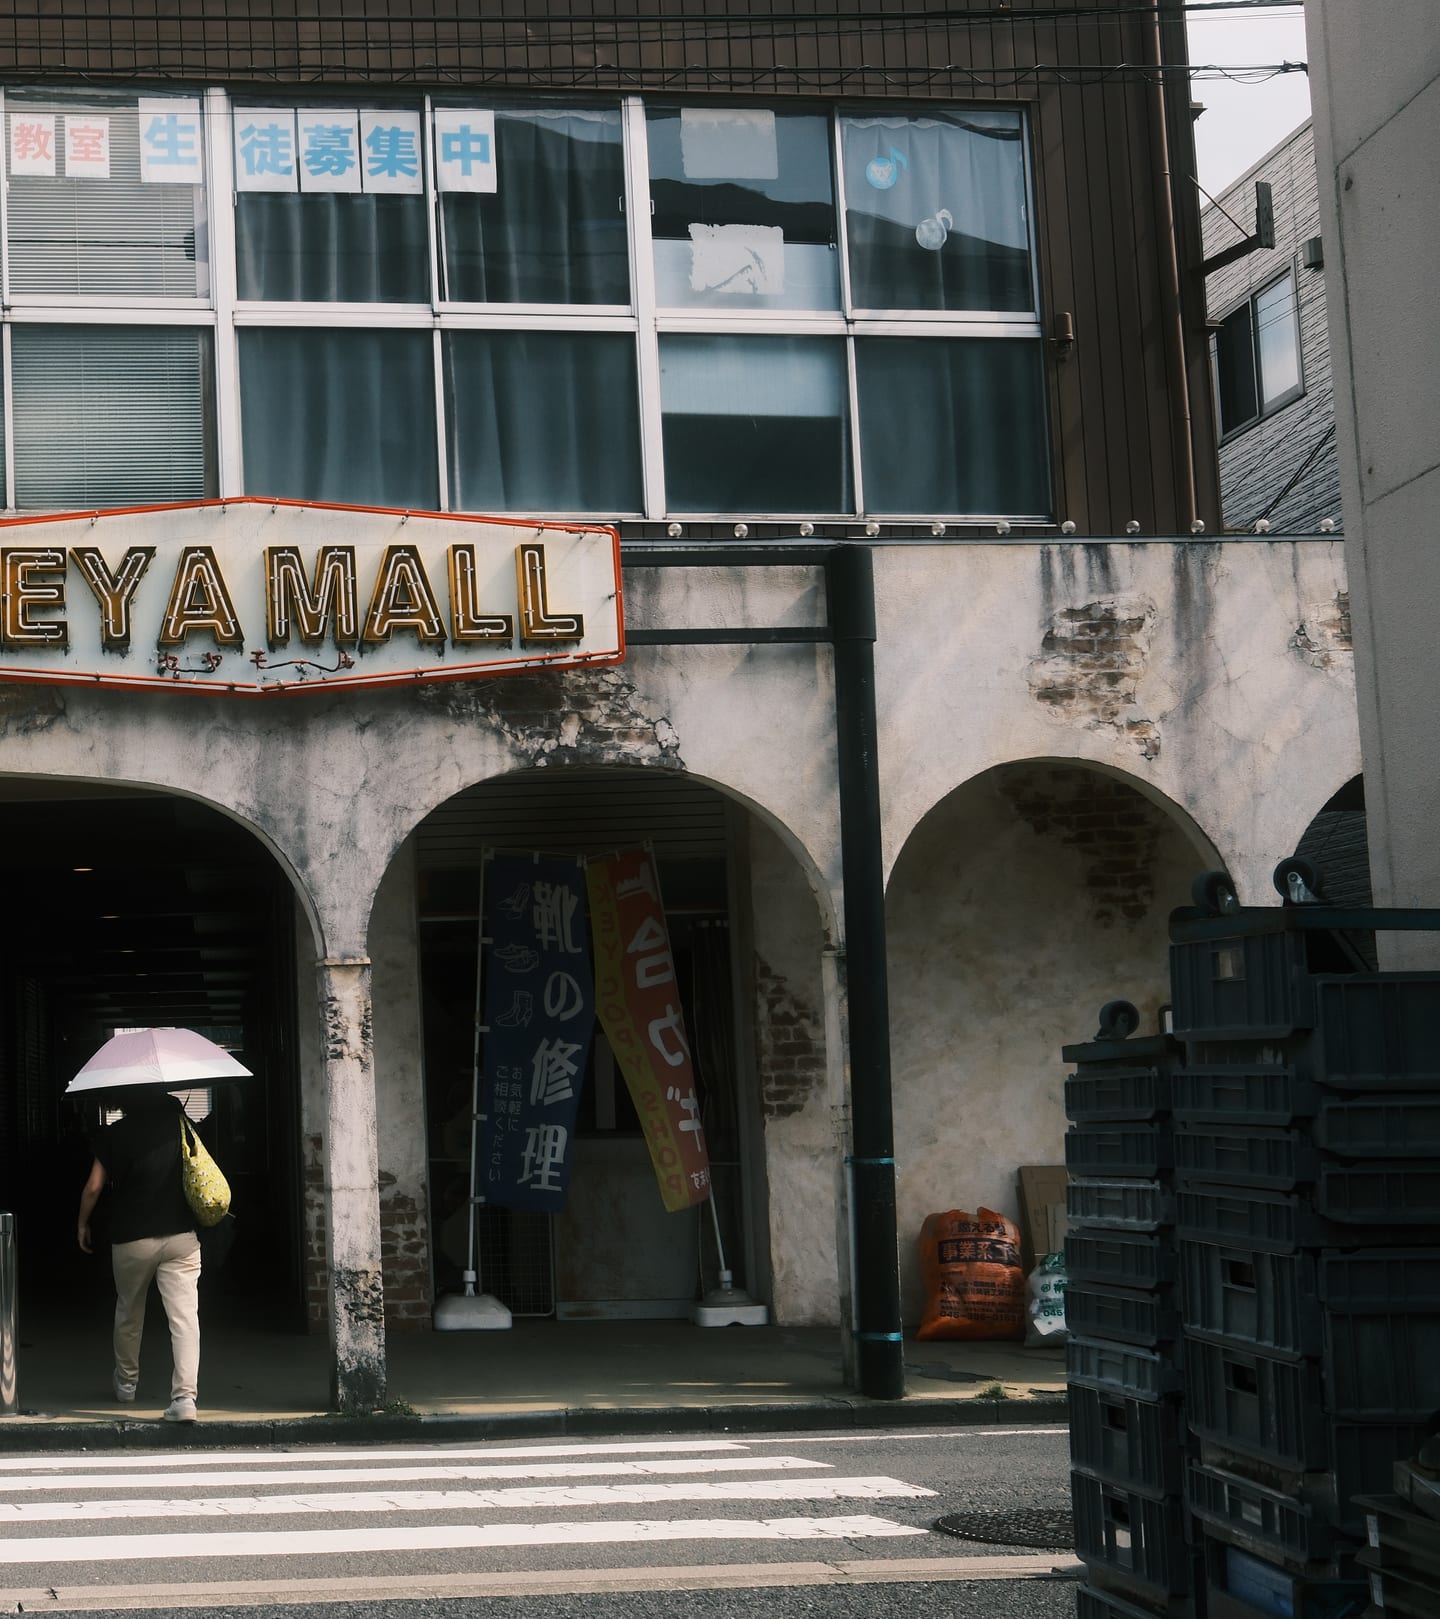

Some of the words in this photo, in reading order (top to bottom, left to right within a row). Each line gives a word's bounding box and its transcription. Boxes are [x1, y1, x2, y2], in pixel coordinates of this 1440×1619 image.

[144, 114, 492, 178] 生徒募集中
[264, 543, 586, 646] MALL
[517, 880, 583, 1192] 靴の修理
